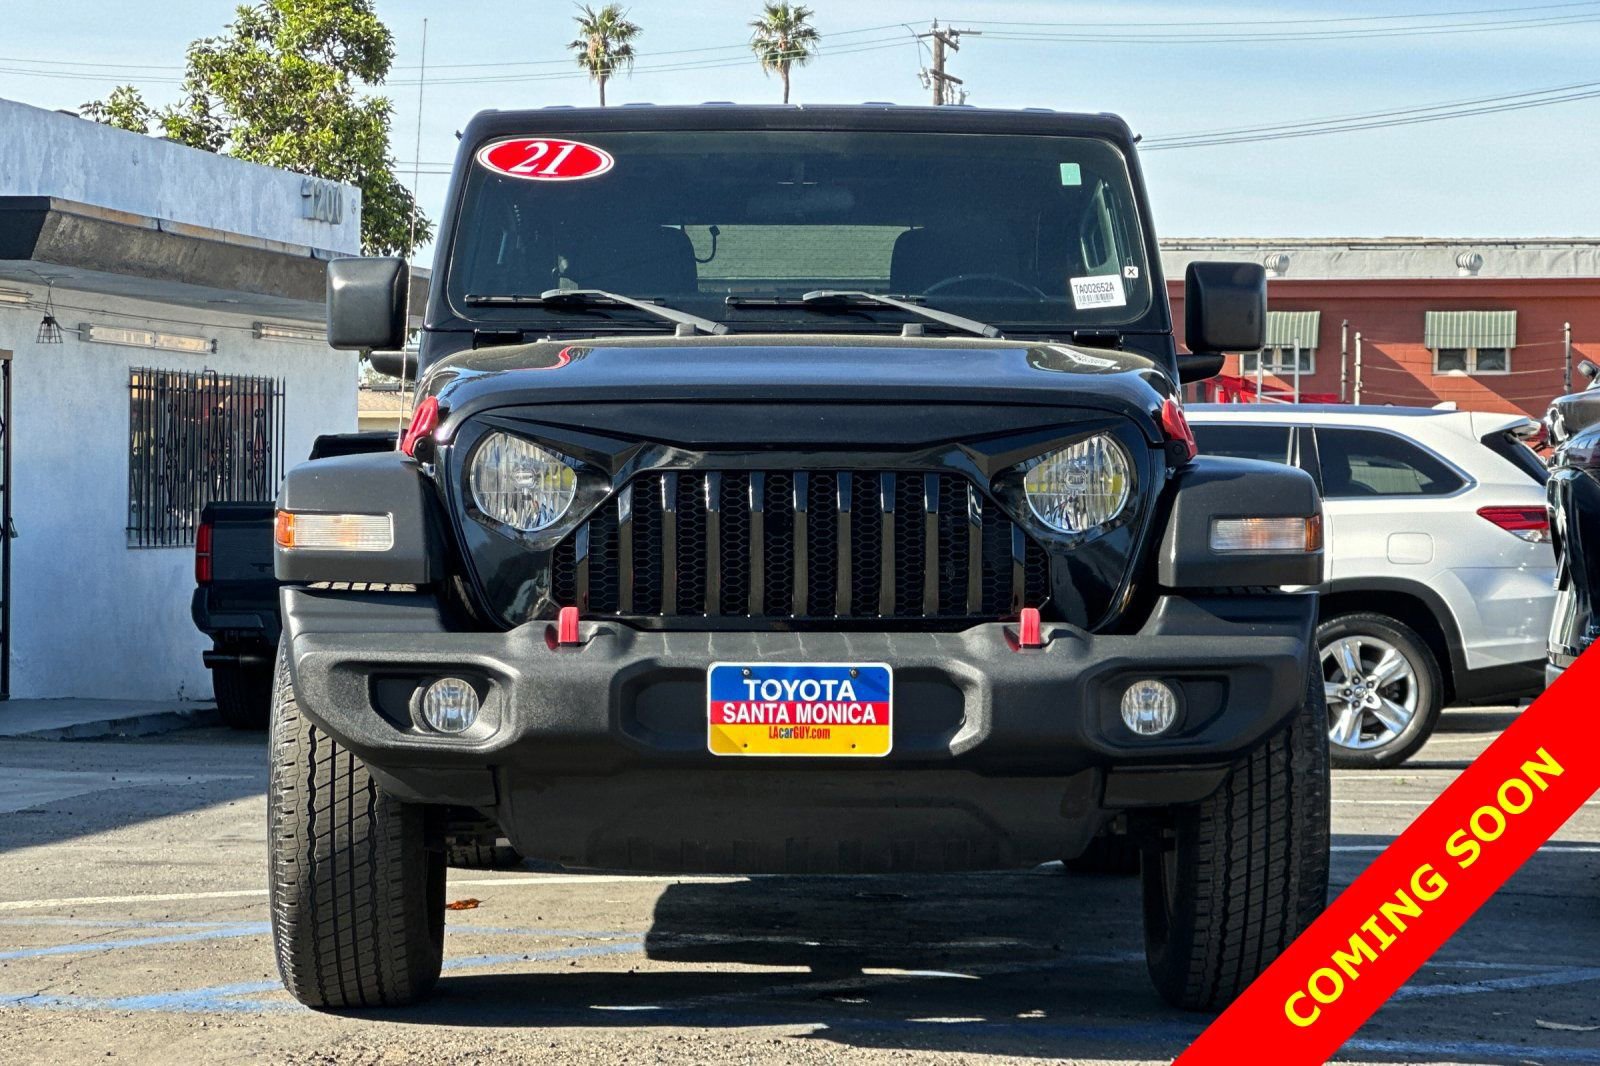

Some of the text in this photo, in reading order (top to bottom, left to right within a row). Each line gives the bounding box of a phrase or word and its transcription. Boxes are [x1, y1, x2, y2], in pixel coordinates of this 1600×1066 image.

[508, 141, 577, 175] 21
[1073, 281, 1115, 294] TA002652A
[743, 678, 857, 702] TOYOTA
[723, 702, 877, 724] SANTA MONICA
[768, 725, 831, 740] LAcarGUY.com
